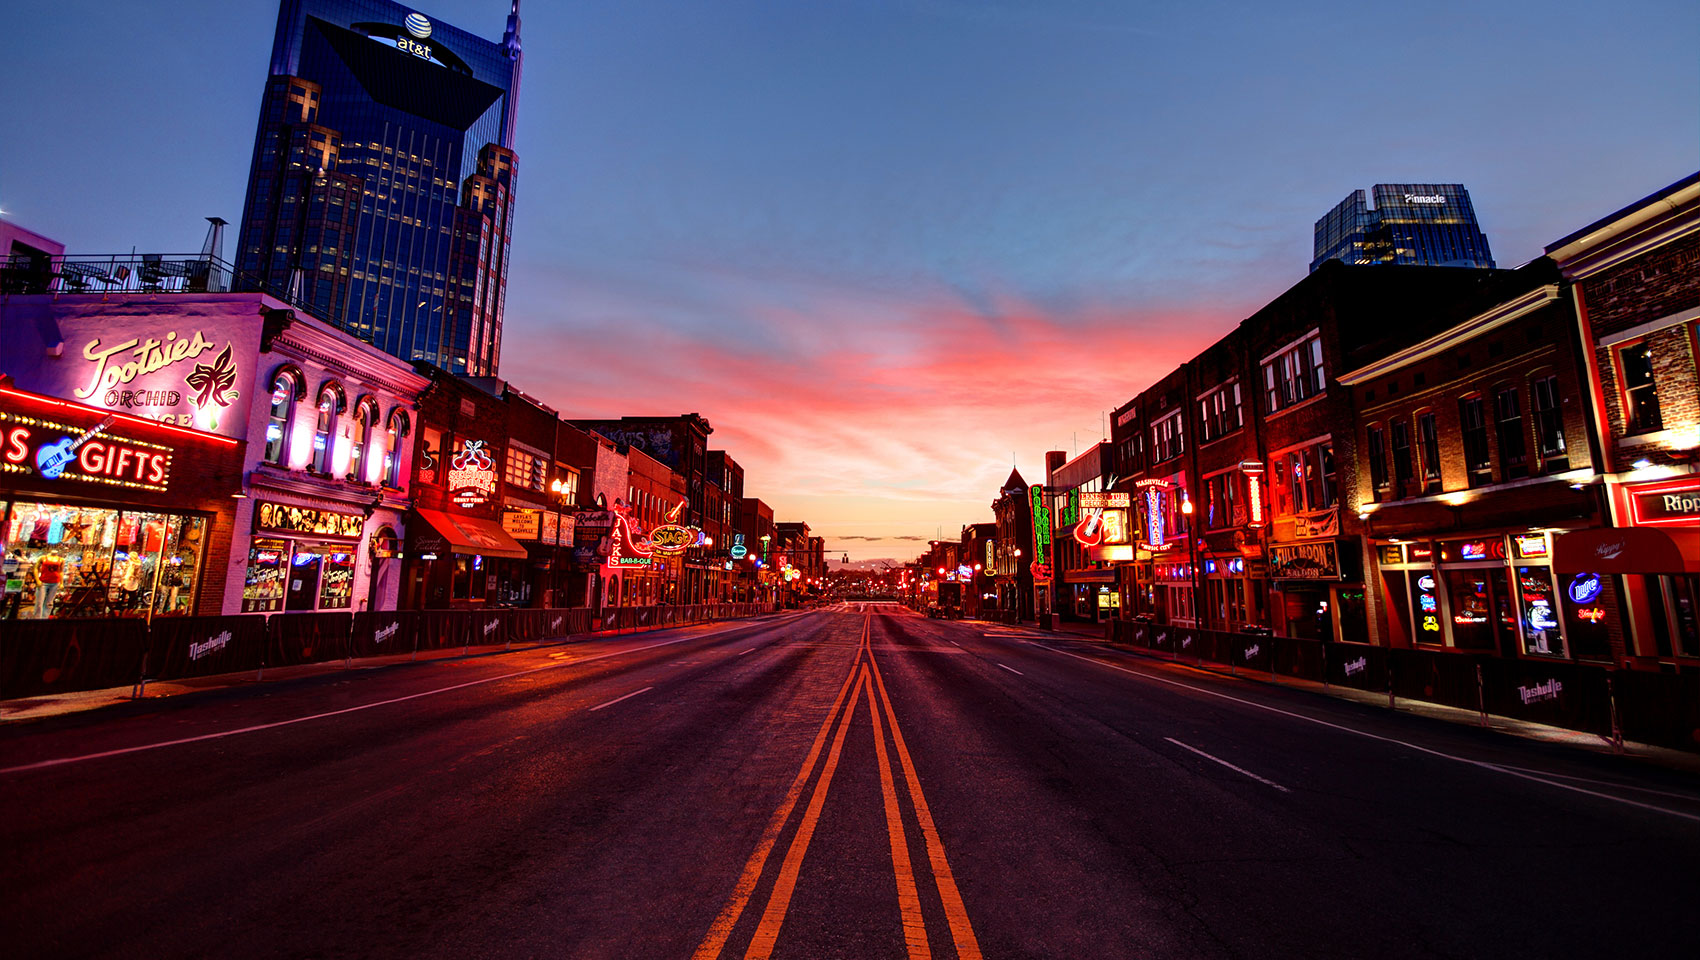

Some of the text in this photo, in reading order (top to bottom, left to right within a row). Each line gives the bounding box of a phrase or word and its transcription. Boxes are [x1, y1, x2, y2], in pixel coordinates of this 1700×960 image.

[397, 37, 432, 60] at&t
[1405, 194, 1446, 204] Pinnacle
[73, 330, 215, 398] Tootsies
[105, 389, 181, 408] ORCHID
[0, 427, 165, 483] S GIFTS
[448, 470, 494, 482] SECOND
[449, 479, 490, 492] FIDDLE
[1135, 479, 1169, 488] NASHVILLE
[1081, 492, 1129, 500] ERNEST TUBB
[1663, 494, 1700, 512] Ripp
[1032, 486, 1045, 564] PARADISE
[1149, 486, 1161, 545] CROSSROADS
[1041, 507, 1050, 545] PARK
[652, 529, 689, 546] STAGE
[620, 557, 652, 565] BAR-B-QUE
[1276, 544, 1328, 569] FULL MOON
[1286, 567, 1319, 577] SALOON
[189, 630, 232, 661] Nashville
[1344, 655, 1366, 676] Nashville
[1517, 678, 1563, 705] Nashville
